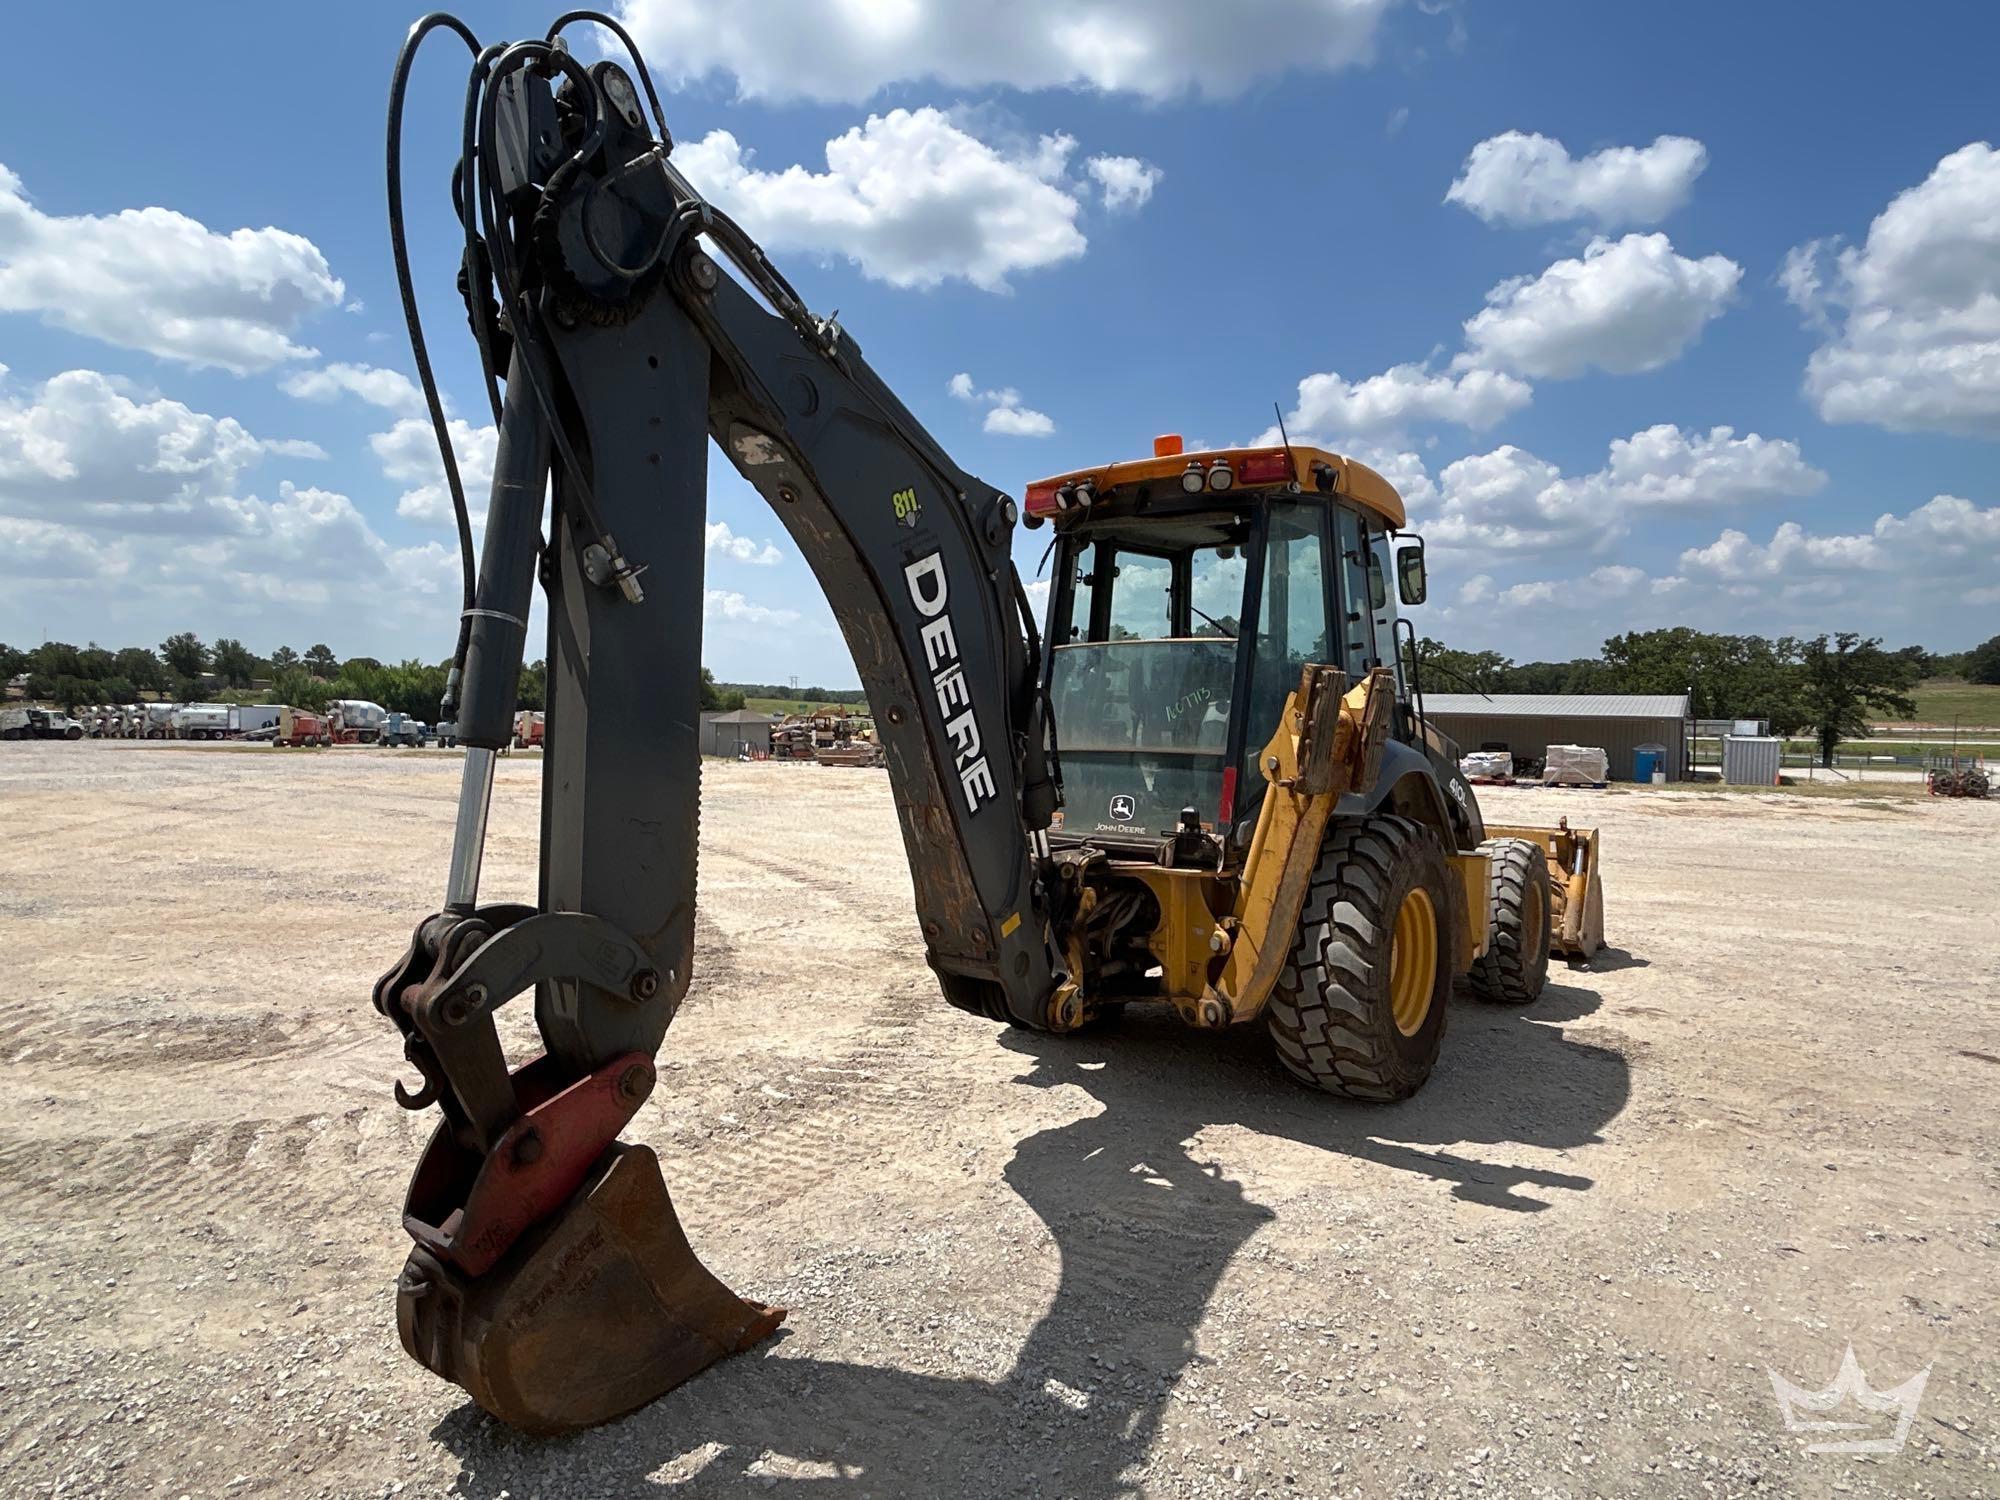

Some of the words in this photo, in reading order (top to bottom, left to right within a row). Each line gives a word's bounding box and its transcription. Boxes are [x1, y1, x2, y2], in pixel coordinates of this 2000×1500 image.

[904, 552, 996, 813] DEERE
[1094, 822, 1117, 832] JOHN
[1117, 824, 1146, 835] DEERE
